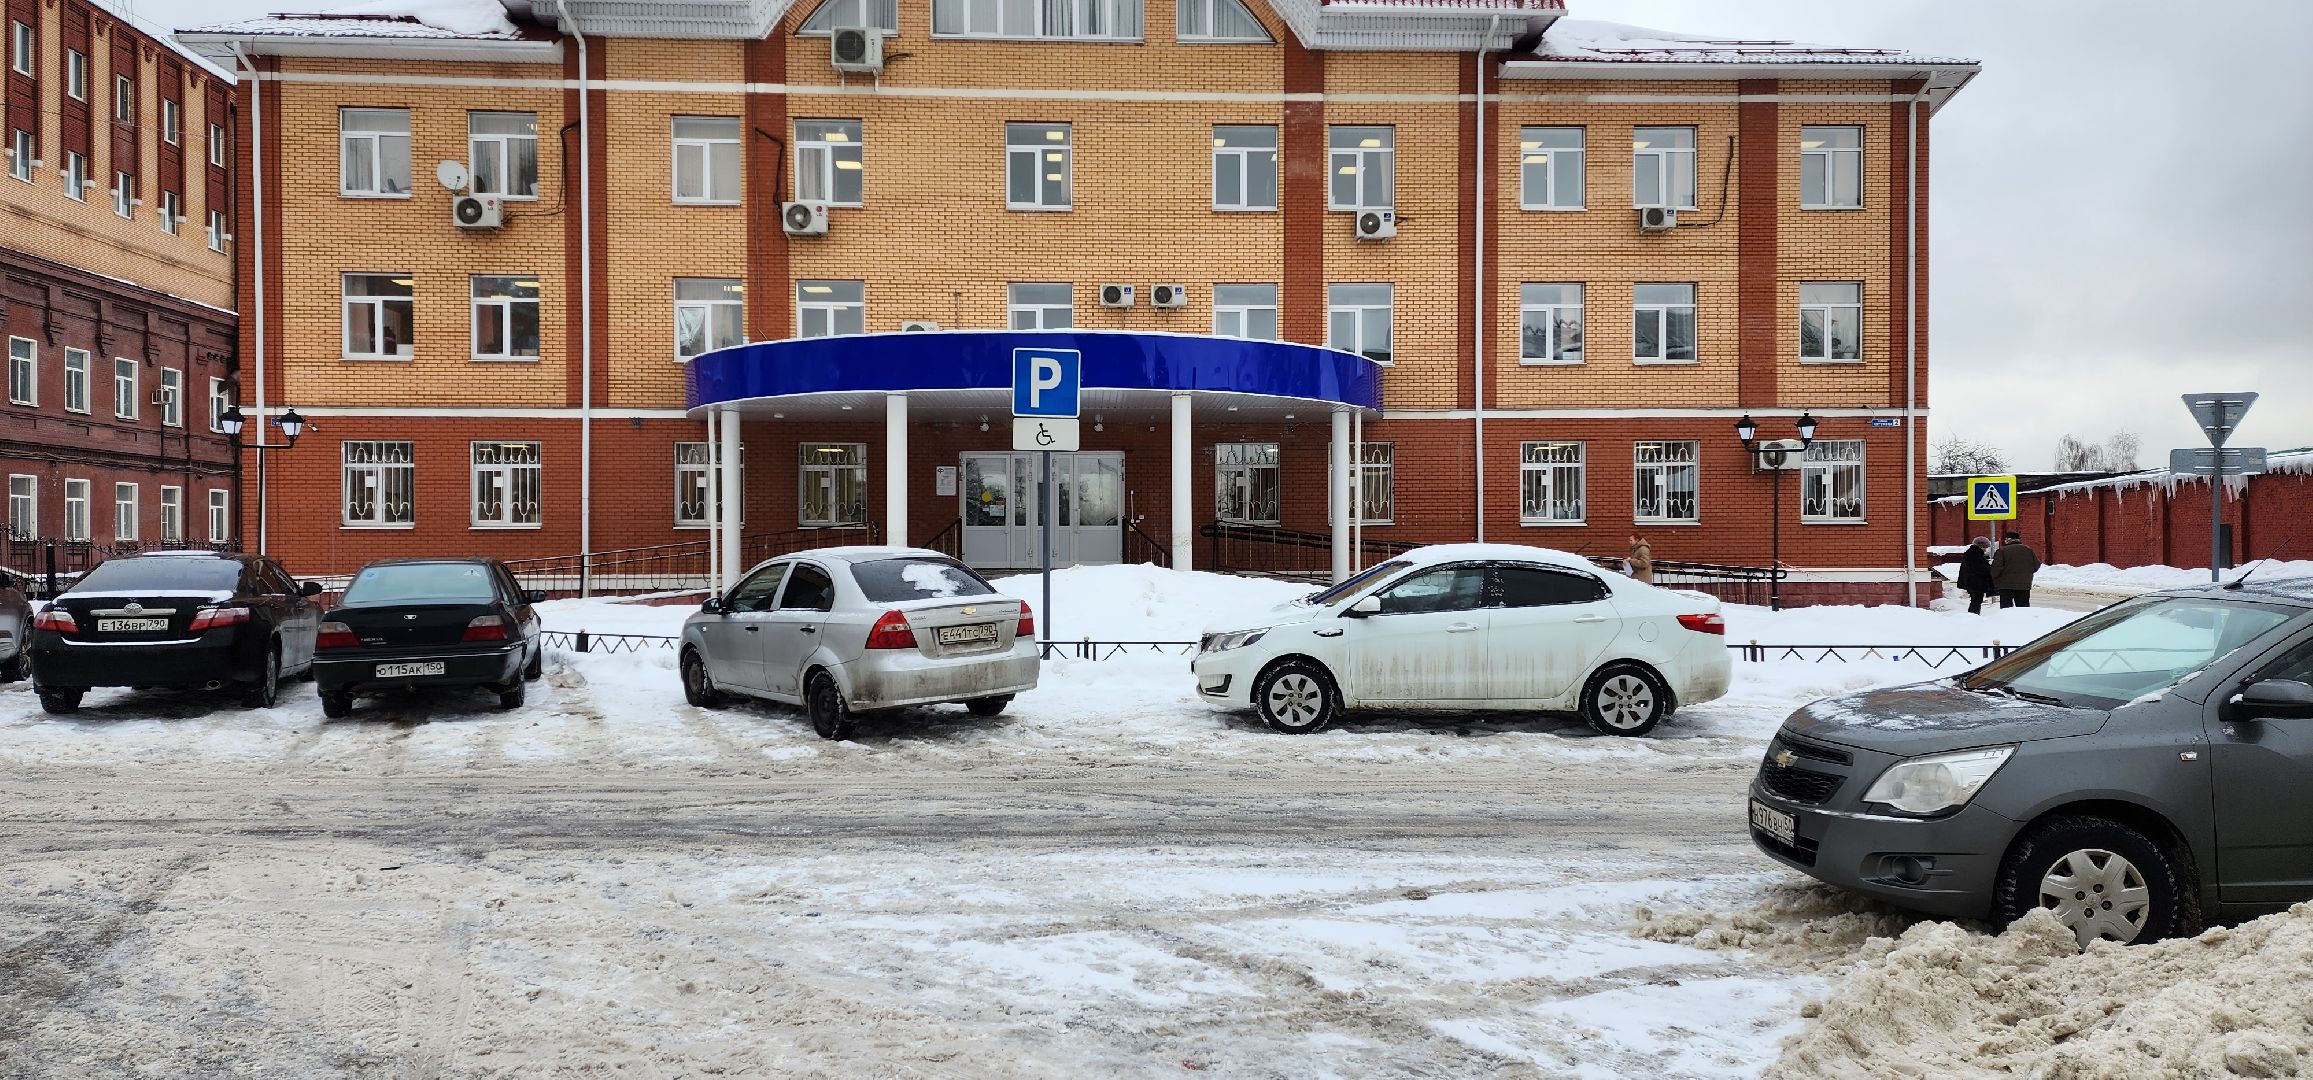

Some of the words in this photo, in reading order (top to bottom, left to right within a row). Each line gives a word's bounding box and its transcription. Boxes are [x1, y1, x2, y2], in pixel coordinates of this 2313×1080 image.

[1030, 357, 1062, 408] P
[148, 619, 165, 628] 790
[425, 663, 443, 671] 150
